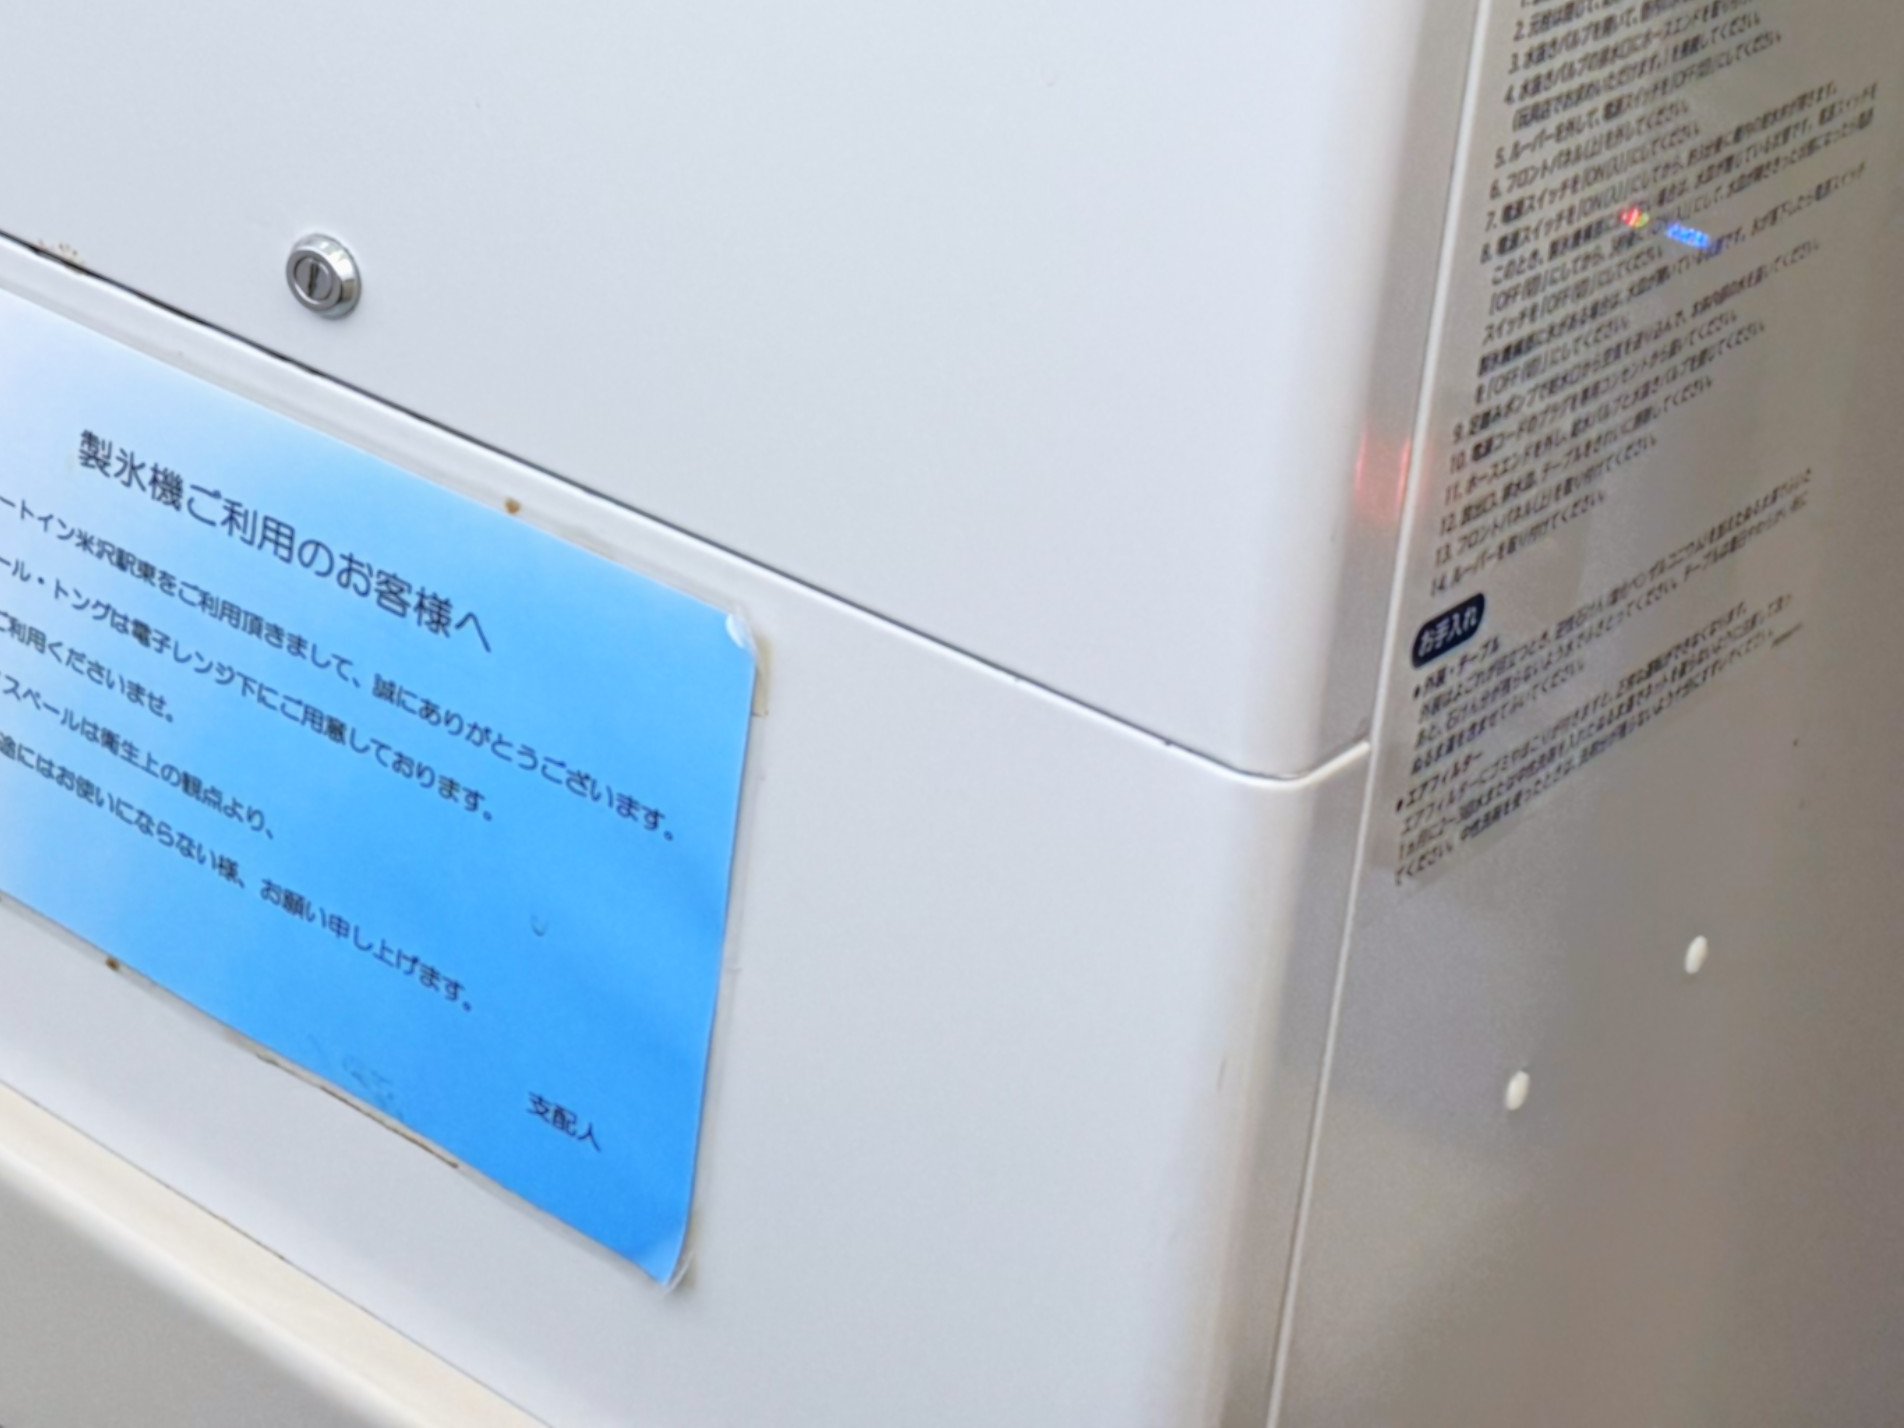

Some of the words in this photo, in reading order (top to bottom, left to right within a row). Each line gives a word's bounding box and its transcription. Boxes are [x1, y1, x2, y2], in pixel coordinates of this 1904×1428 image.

[76, 427, 493, 655] 製氷機ご利用のお客様へ
[1416, 600, 1479, 662] お手入れ
[1403, 743, 1484, 811] エアフィルター
[526, 1089, 602, 1151] 支配人
